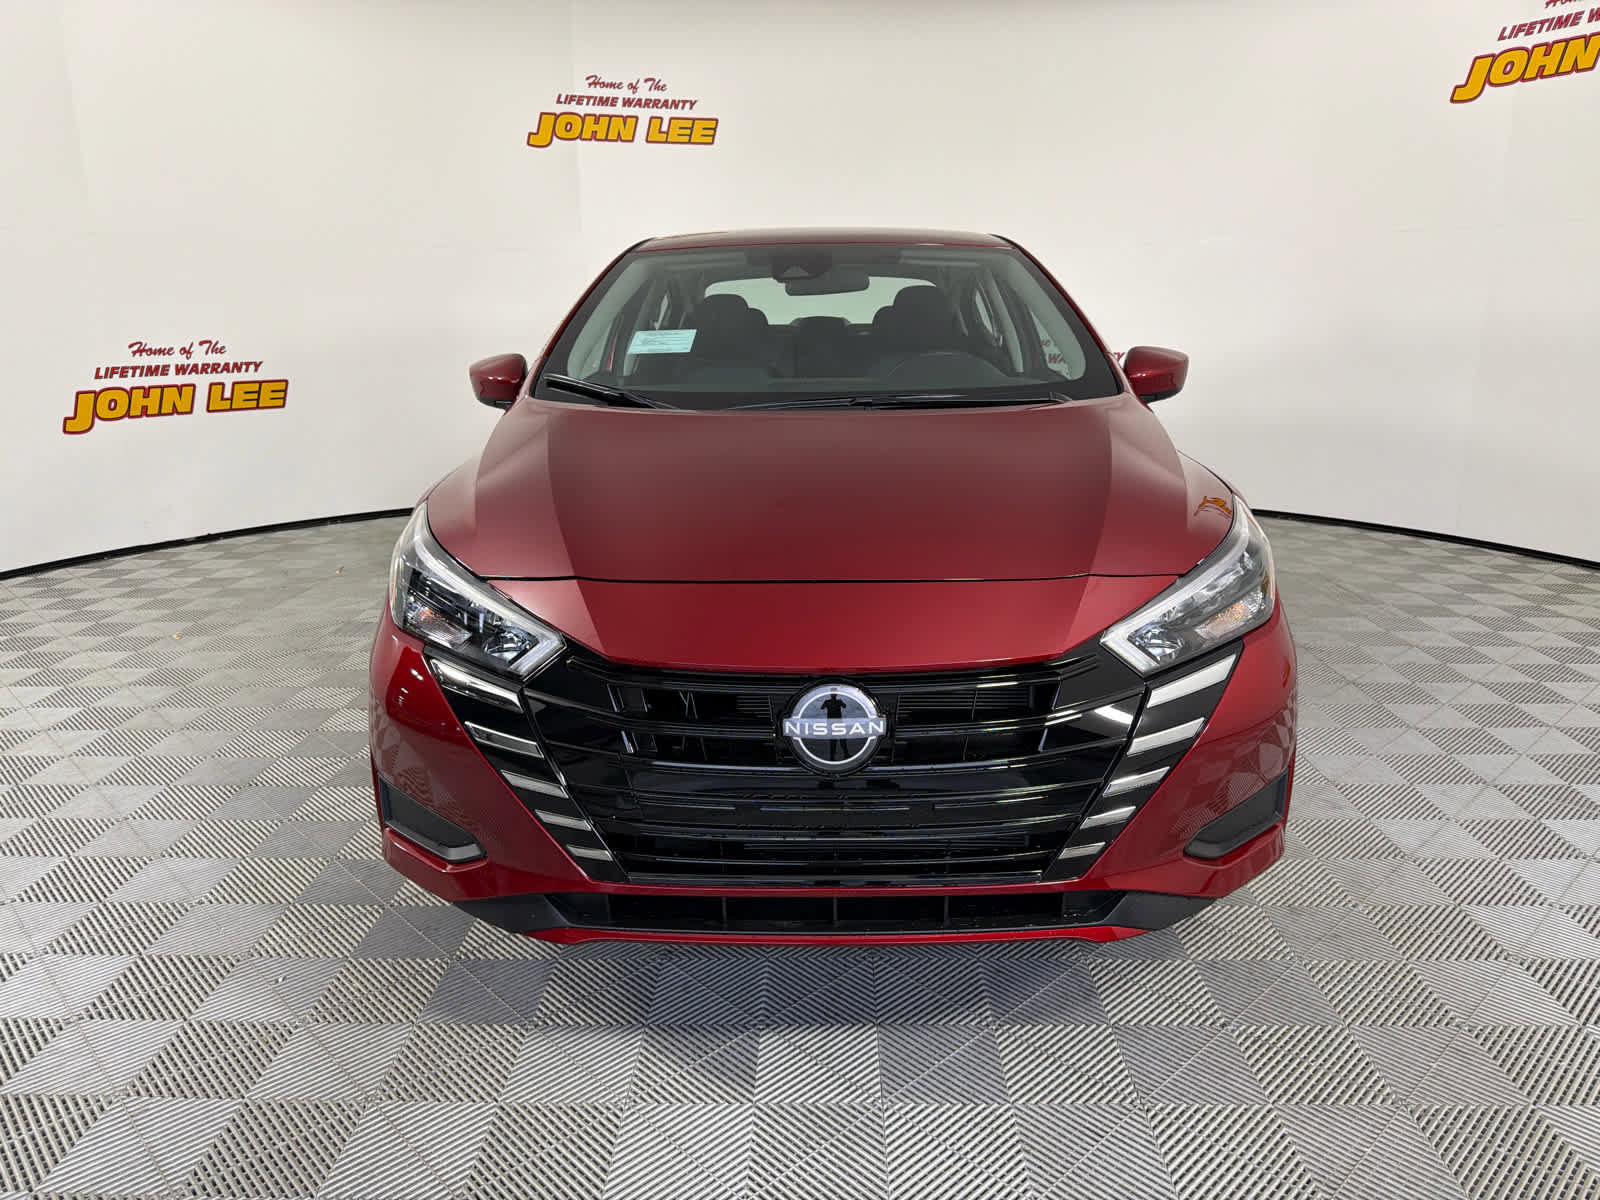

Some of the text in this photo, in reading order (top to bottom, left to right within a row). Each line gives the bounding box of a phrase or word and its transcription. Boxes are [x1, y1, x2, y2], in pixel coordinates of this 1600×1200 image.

[1497, 11, 1584, 41] LIFETIME
[1450, 32, 1600, 104] JOHN
[585, 75, 667, 94] Home of The
[556, 94, 697, 110] LIFETIME WARRANTY
[527, 112, 718, 148] JOHN LEE
[128, 340, 226, 359] Home of The
[95, 361, 262, 379] LIFETIME WARRANTY
[63, 380, 288, 434] JOHN LEE
[785, 721, 884, 736] NISSAN
